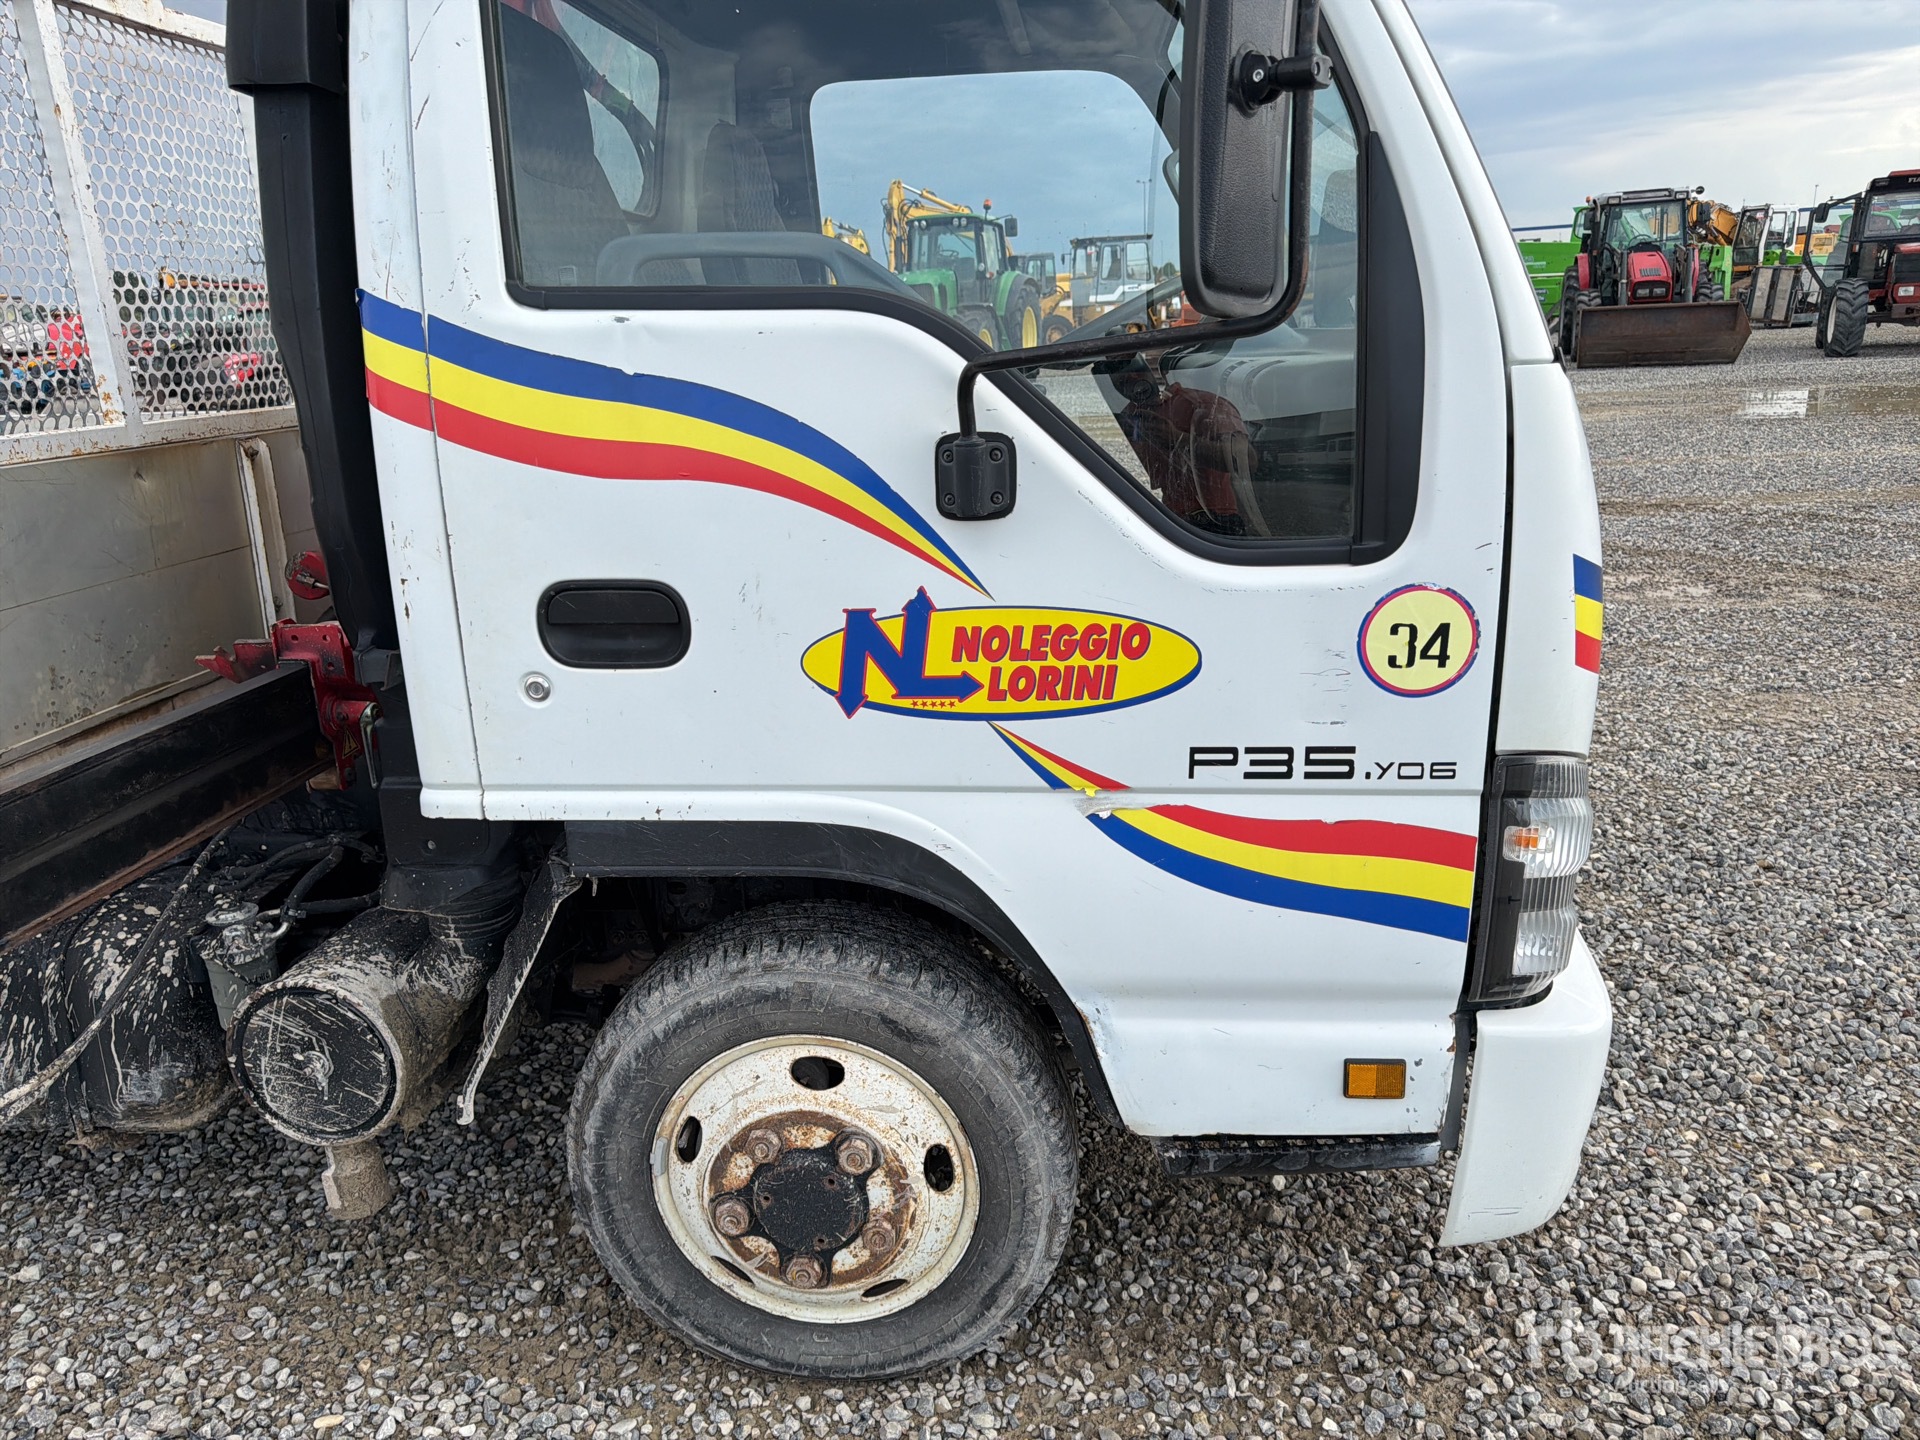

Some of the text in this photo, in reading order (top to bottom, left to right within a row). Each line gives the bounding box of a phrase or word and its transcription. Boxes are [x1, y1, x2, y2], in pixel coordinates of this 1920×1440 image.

[951, 621, 1151, 662] NOLEGGIO
[1387, 622, 1451, 669] 34
[987, 664, 1118, 702] LORINI
